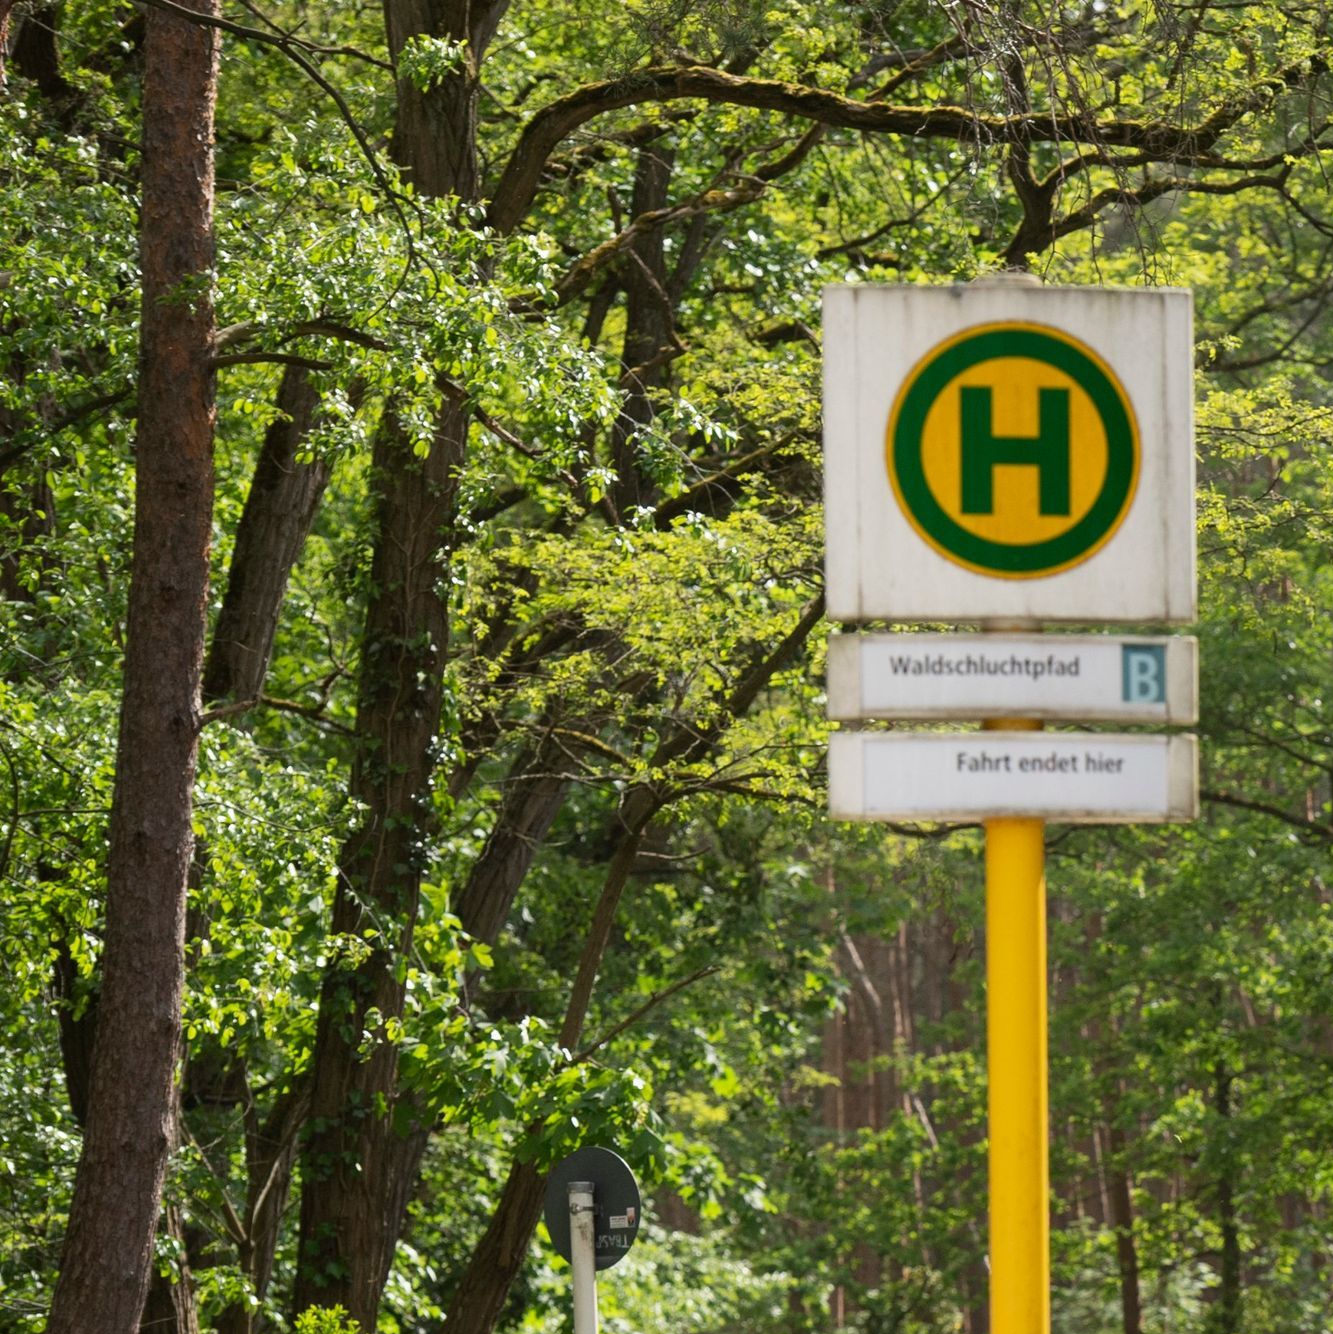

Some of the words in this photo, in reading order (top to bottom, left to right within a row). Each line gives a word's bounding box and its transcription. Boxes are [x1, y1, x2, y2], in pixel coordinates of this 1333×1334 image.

[961, 386, 1071, 516] H
[889, 654, 1080, 682] Waldschluchtpfad
[1129, 653, 1159, 703] B
[957, 752, 1011, 773] Fahrt
[1018, 752, 1078, 773] endet
[1084, 752, 1126, 773] hier
